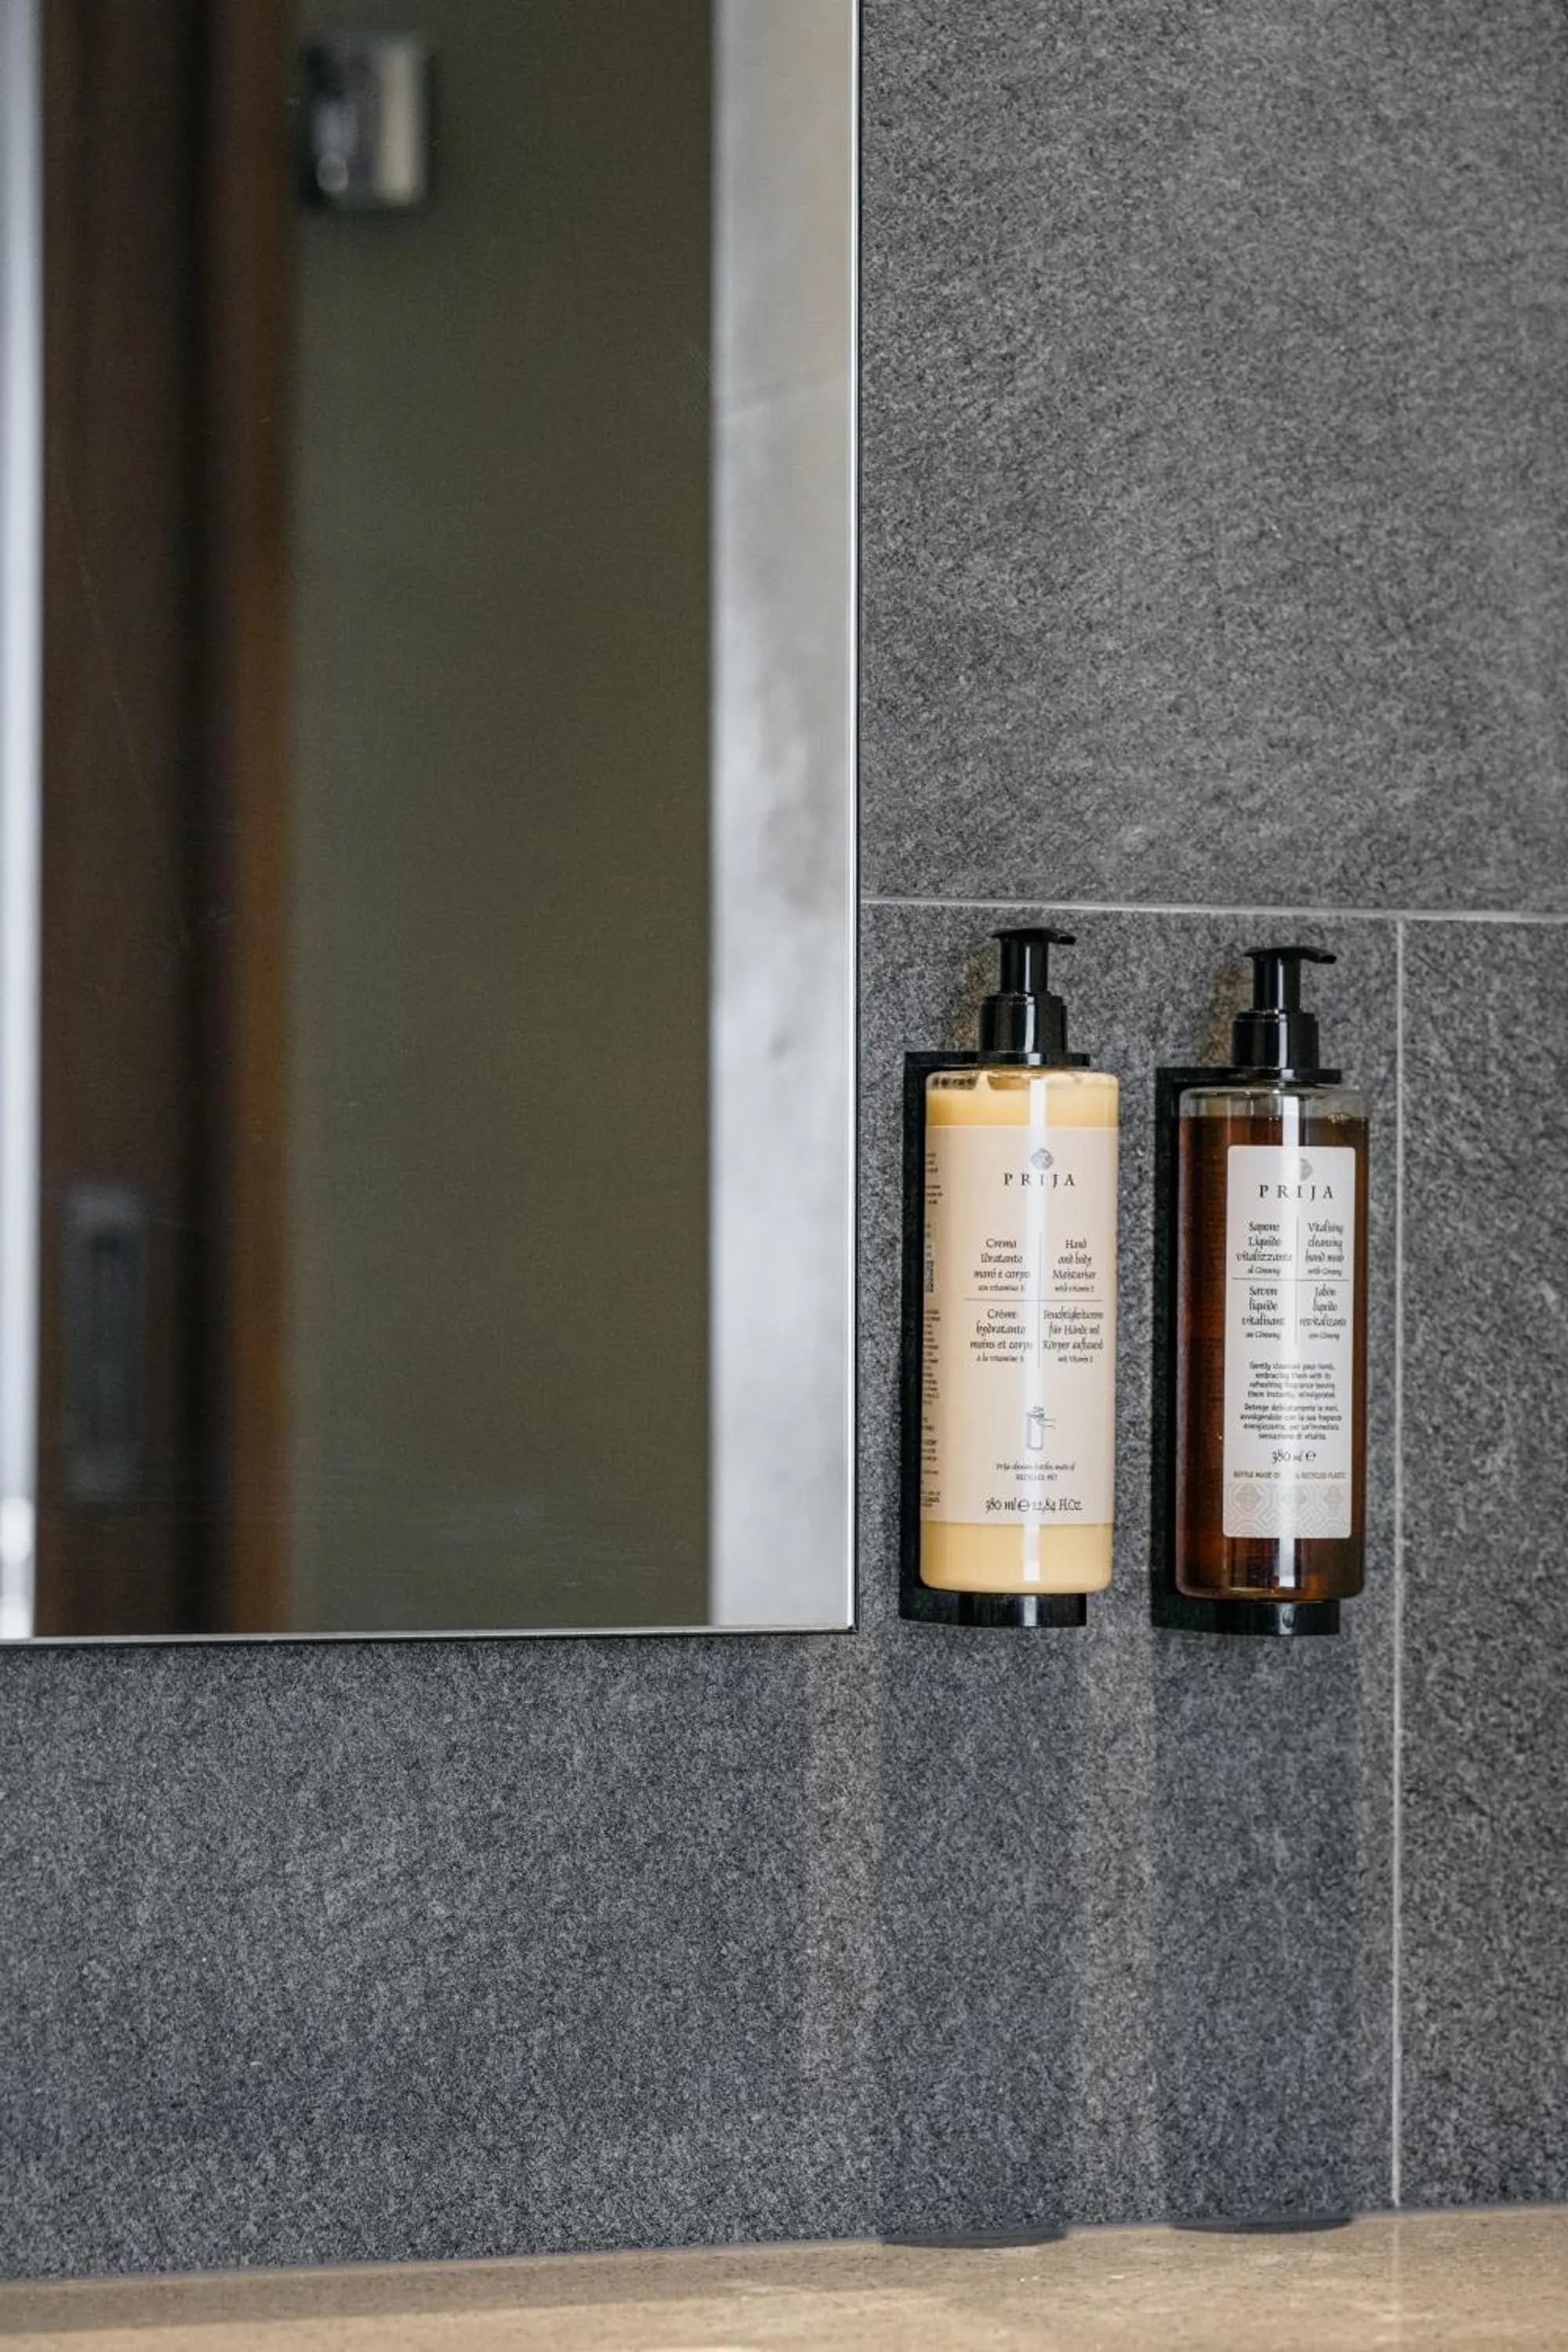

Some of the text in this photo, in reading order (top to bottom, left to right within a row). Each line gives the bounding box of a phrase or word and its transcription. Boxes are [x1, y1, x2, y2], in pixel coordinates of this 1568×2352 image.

[1004, 1173, 1076, 1188] PRIJA
[1259, 1184, 1334, 1201] PRIJA
[1248, 1221, 1280, 1234] Sapone
[985, 1238, 1017, 1249] Crema
[1065, 1239, 1087, 1249] Hand
[1058, 1251, 1092, 1267] and body
[1249, 1286, 1278, 1296] Savon
[1271, 1449, 1291, 1465] 380
[985, 1497, 1003, 1513] 380
